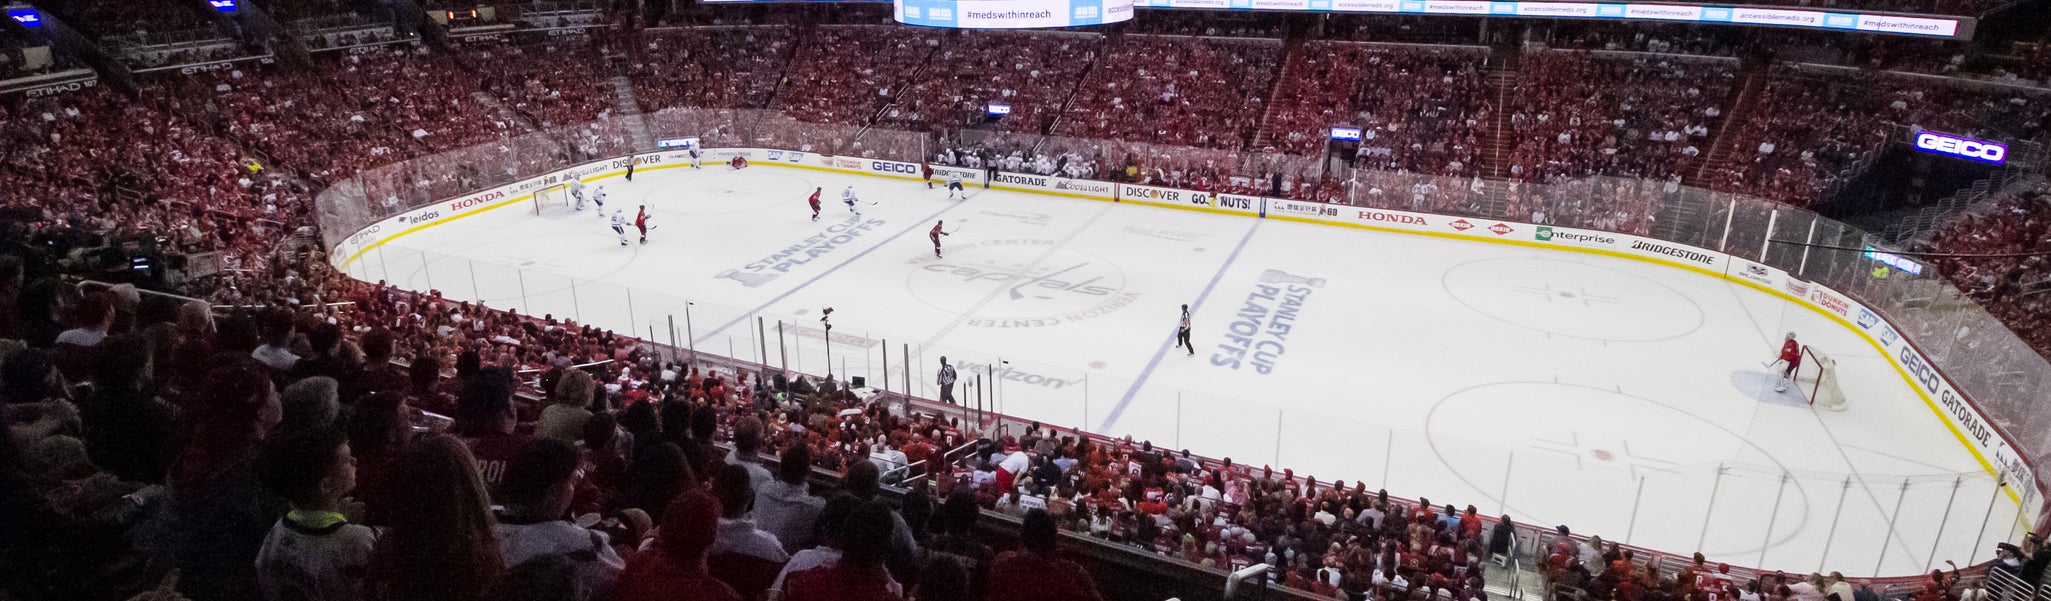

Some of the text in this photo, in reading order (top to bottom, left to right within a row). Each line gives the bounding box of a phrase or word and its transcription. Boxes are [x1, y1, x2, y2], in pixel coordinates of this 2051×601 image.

[967, 9, 1051, 20] #medswithinreach
[1740, 12, 1815, 24] accessiblemeds.org
[1863, 19, 1940, 32] #medswithinreach
[26, 82, 81, 97] ETIHAD
[1916, 133, 2005, 162] GEICO
[612, 154, 662, 169] DISOVER
[872, 161, 916, 174] GEICO
[996, 174, 1047, 187] GATORADE
[1088, 184, 1109, 193] LIGHT
[451, 191, 506, 211] HONDA
[1220, 195, 1251, 210] NUTS!
[409, 210, 440, 225] leidos
[1357, 211, 1428, 226] HONDA
[744, 232, 827, 272] STANLEY
[771, 218, 886, 273] PLAYOFFS
[1631, 240, 1715, 265] BRIDGESTONE
[1821, 300, 1848, 317] DONUTS
[1210, 283, 1281, 370] PLAYOFFS
[1250, 284, 1312, 375] STANLEY CUP
[957, 360, 1064, 389] verizon
[1900, 346, 1940, 395] GEICO
[1941, 389, 1992, 448] GATORADE
